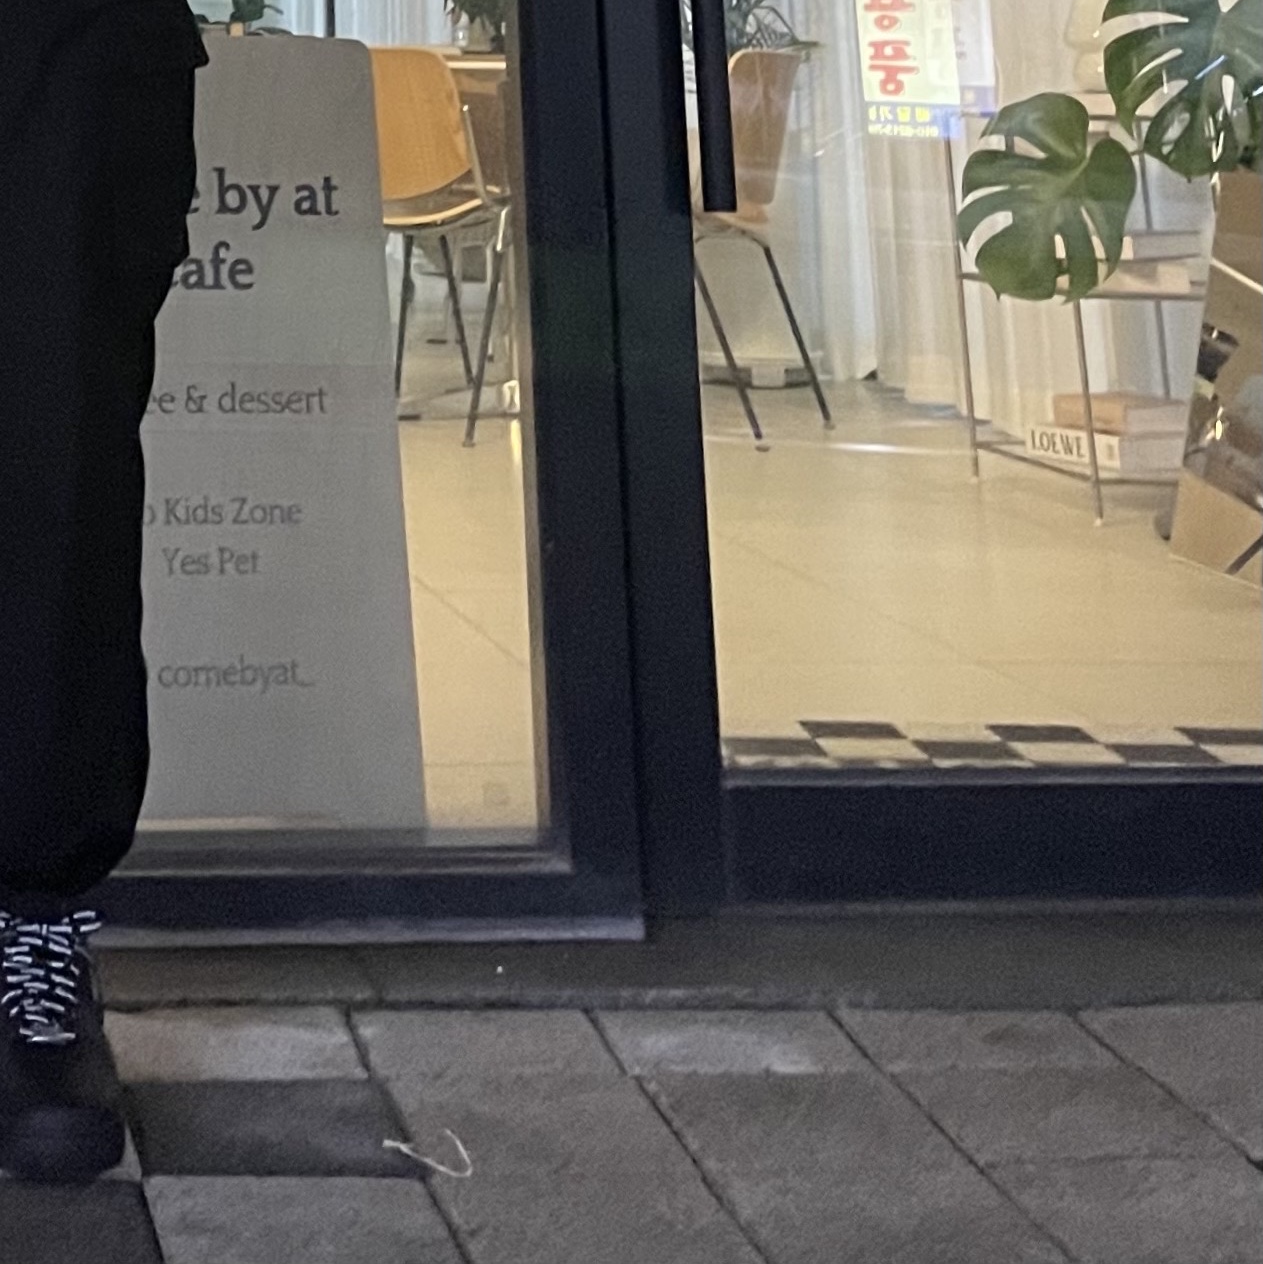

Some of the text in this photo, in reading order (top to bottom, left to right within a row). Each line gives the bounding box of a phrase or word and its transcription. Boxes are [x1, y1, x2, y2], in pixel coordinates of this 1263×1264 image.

[213, 166, 280, 231] by
[293, 176, 340, 216] at
[173, 241, 255, 290] afe
[185, 384, 207, 414] &
[218, 382, 329, 414] dessert
[1030, 428, 1086, 459] LOEWE
[164, 496, 224, 525] Kids
[230, 497, 302, 525] Zone
[162, 547, 261, 576] Yes Pet
